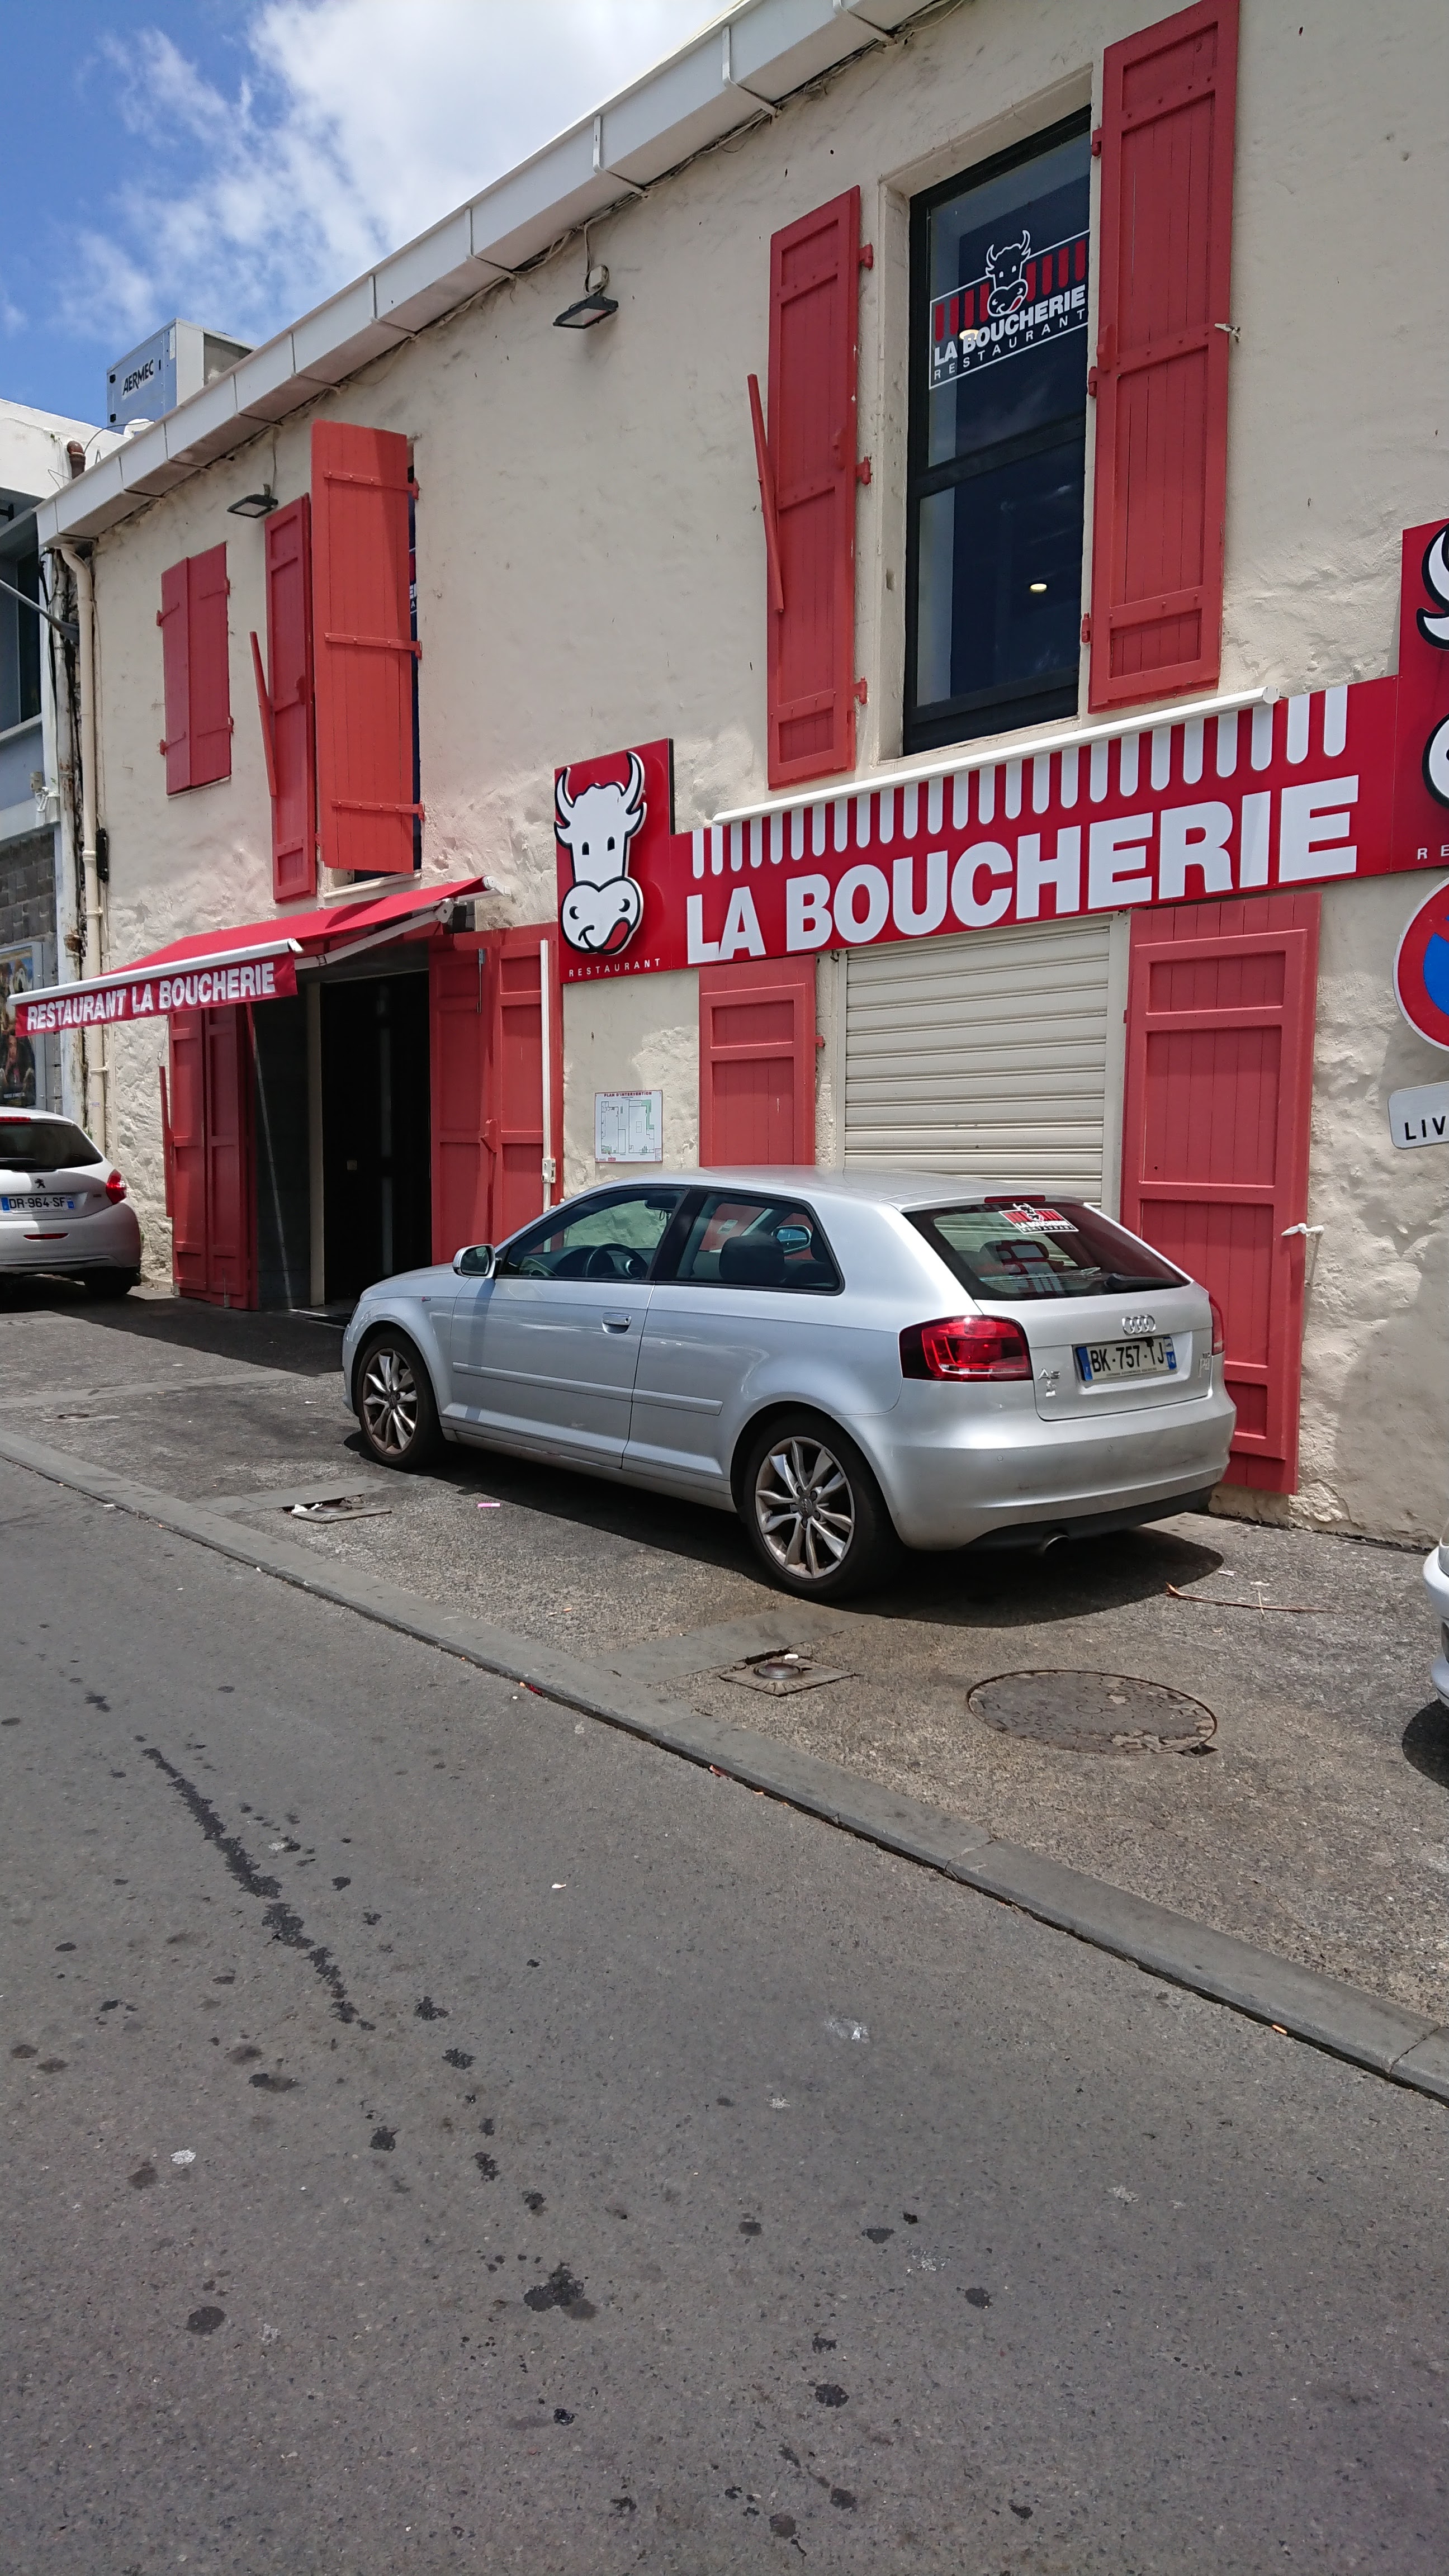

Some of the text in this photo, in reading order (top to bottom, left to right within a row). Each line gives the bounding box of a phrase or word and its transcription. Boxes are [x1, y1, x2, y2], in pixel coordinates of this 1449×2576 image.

[934, 284, 1086, 367] LA BOUCHERIE
[934, 308, 1086, 381] RESTAURANT
[122, 359, 154, 396] AERMEC
[686, 774, 1359, 965] LA BOUCHERIE
[27, 962, 275, 1030] RESTAURANT LA BOUCHERIE
[569, 958, 660, 977] RESTAURANT
